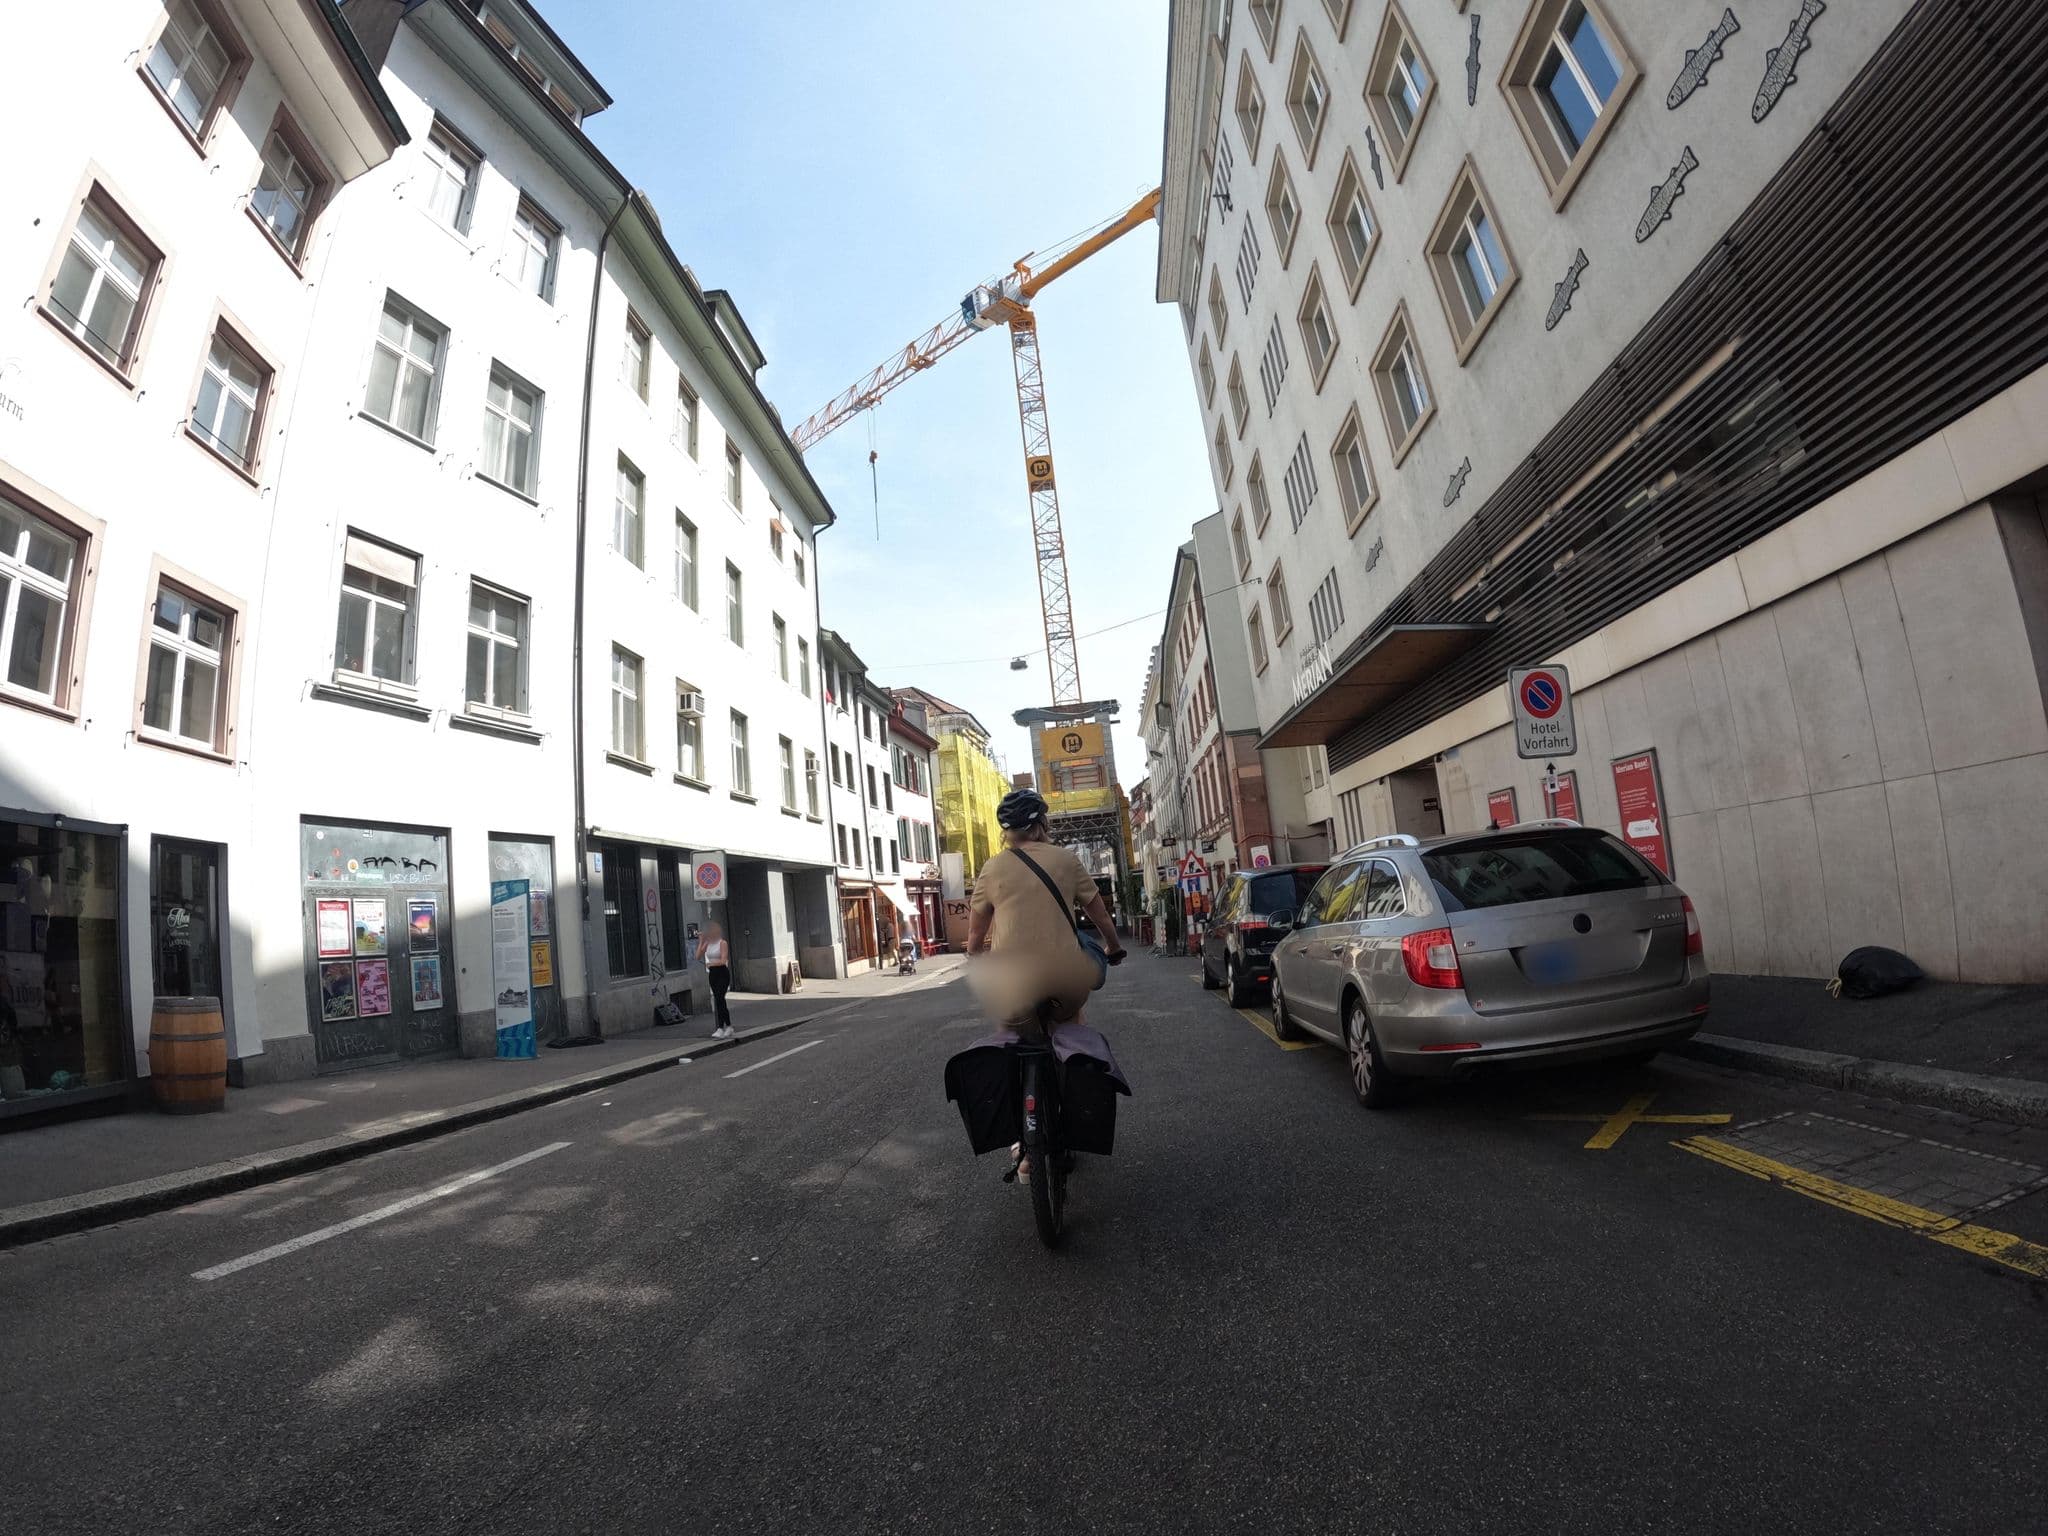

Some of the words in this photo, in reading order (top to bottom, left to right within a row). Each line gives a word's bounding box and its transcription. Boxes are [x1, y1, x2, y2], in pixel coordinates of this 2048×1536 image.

[1292, 641, 1334, 707] MERIAN
[1530, 721, 1560, 734] Hotel
[1523, 736, 1570, 749] Vorfahrt
